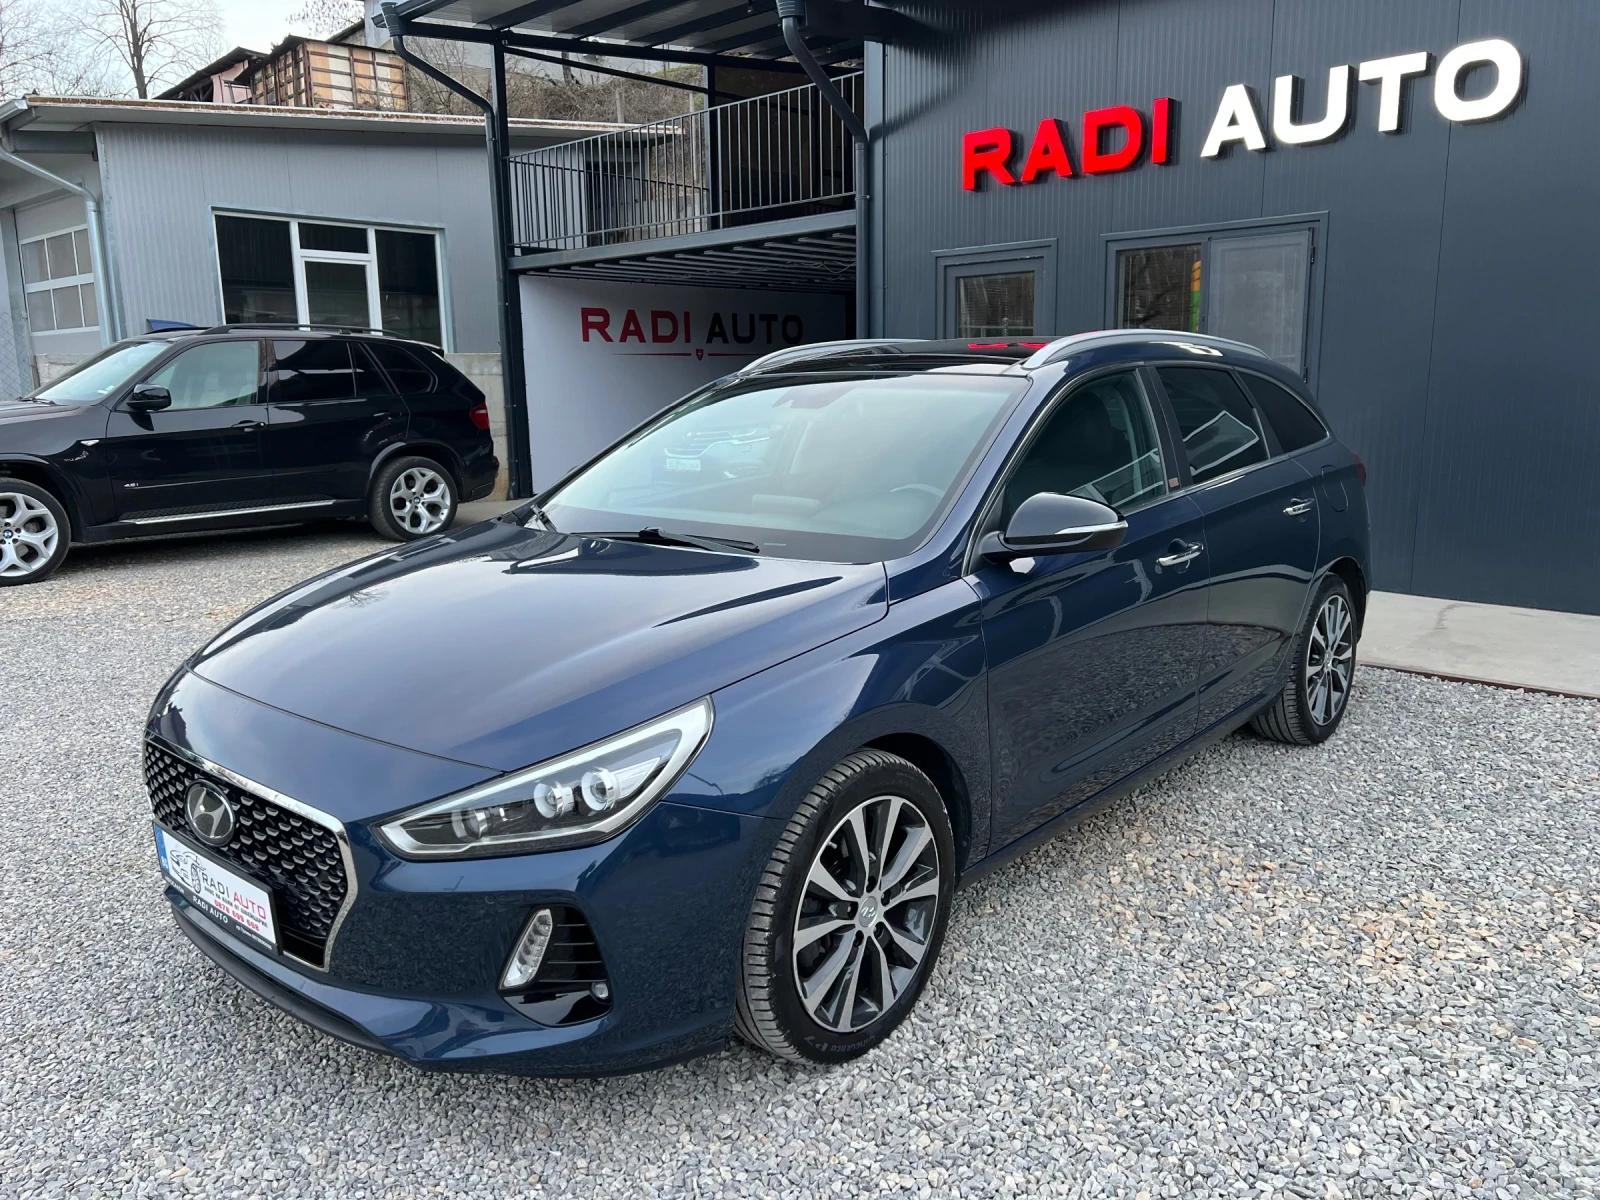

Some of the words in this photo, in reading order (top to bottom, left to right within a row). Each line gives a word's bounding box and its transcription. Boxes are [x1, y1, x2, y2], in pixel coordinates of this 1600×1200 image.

[962, 97, 1178, 191] RADI
[1200, 38, 1523, 159] AUTO
[580, 307, 692, 344] RADI
[705, 312, 804, 345] AUTO
[192, 895, 209, 912] RADI
[209, 907, 229, 924] AUTO
[201, 871, 230, 898] RADI
[233, 891, 267, 920] AUTO
